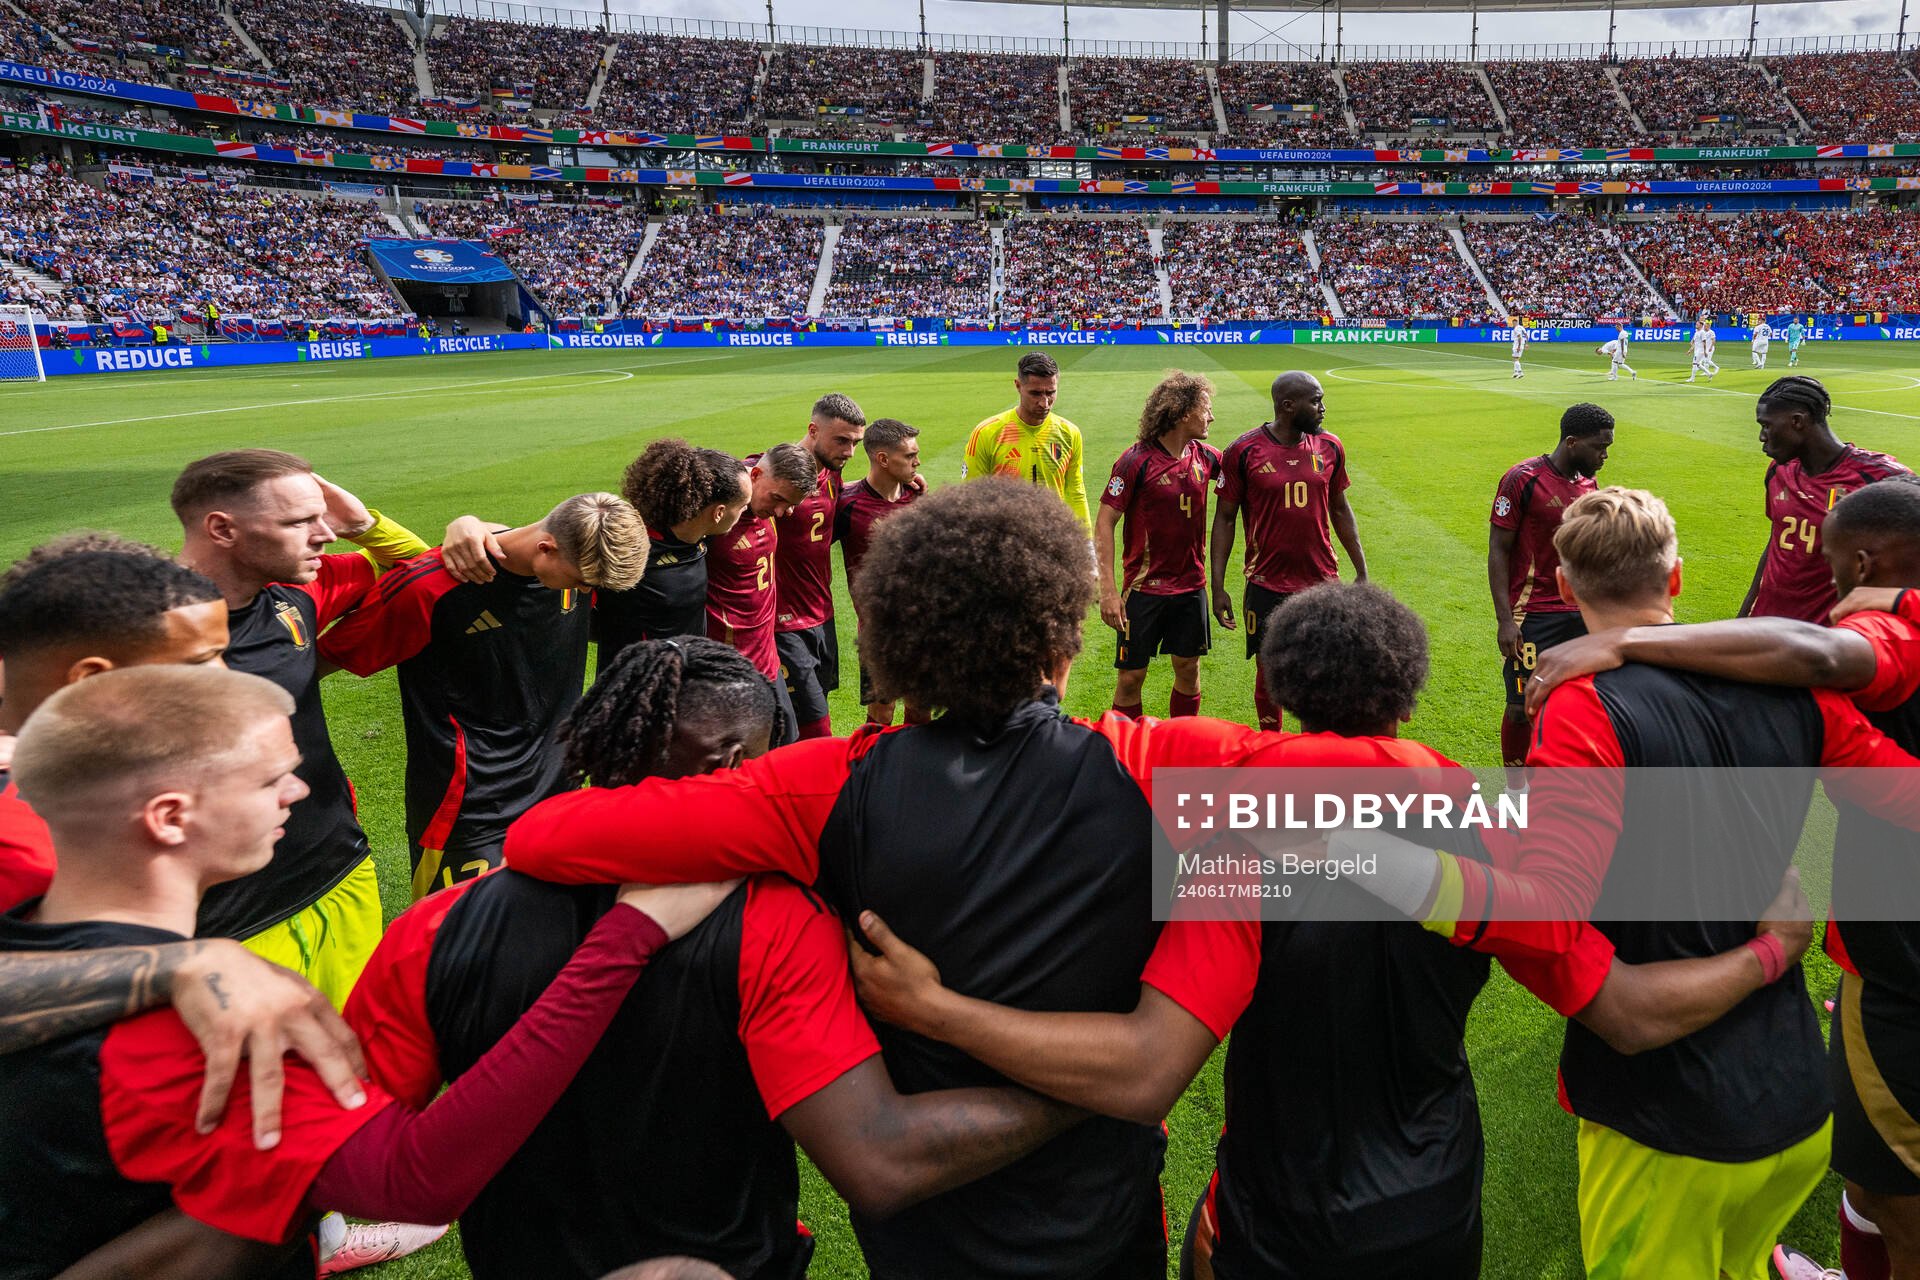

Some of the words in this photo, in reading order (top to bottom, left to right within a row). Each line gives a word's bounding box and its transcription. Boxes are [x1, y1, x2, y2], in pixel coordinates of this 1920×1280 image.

[802, 141, 879, 152] FRANKFURT
[1698, 148, 1771, 158] FRANKFURT
[1263, 184, 1332, 193] FRANKFURT
[1536, 319, 1592, 329] HARZBURG
[569, 334, 645, 347] RECOVER
[729, 333, 793, 346] REDUCE
[887, 332, 938, 345] REUSE
[1028, 332, 1095, 344] RECYCLE
[1174, 331, 1243, 343] RECOVER
[1311, 330, 1420, 342] FRANKFURT
[1635, 329, 1681, 340] REUSE
[439, 336, 491, 352] RECYCLE
[310, 342, 362, 360] REUSE
[96, 348, 193, 371] REDUCE
[1284, 481, 1308, 509] 10
[1179, 493, 1192, 519] 4
[810, 512, 825, 543] 2
[1779, 516, 1817, 554] 24
[756, 551, 775, 592] 21
